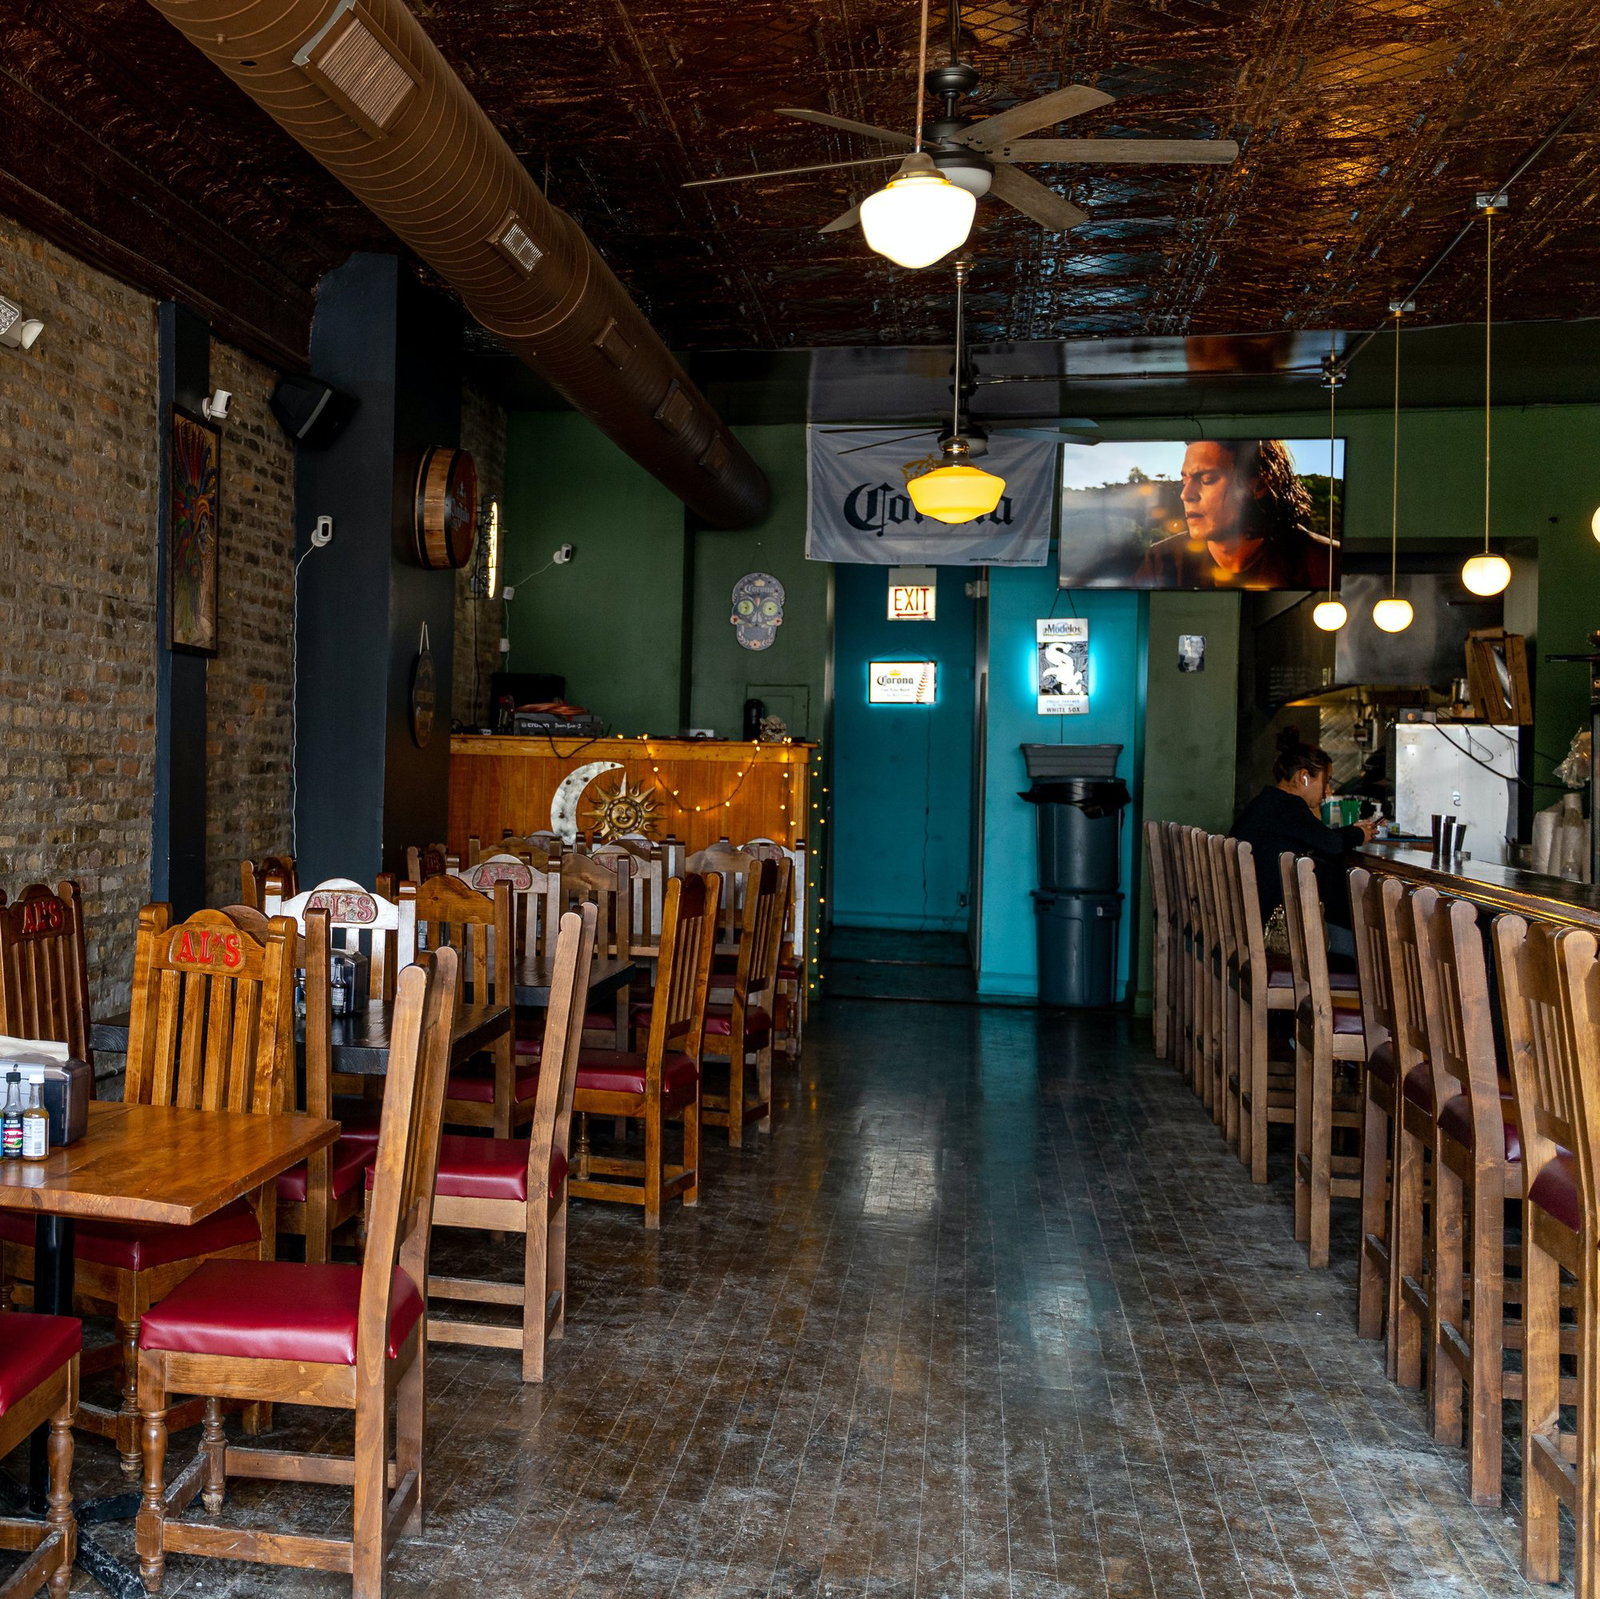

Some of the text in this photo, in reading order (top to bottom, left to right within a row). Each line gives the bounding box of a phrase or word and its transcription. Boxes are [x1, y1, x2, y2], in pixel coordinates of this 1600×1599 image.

[844, 482, 1016, 537] Coa
[894, 588, 929, 611] EXIT
[877, 675, 914, 686] Corona
[175, 929, 241, 968] AL'S
